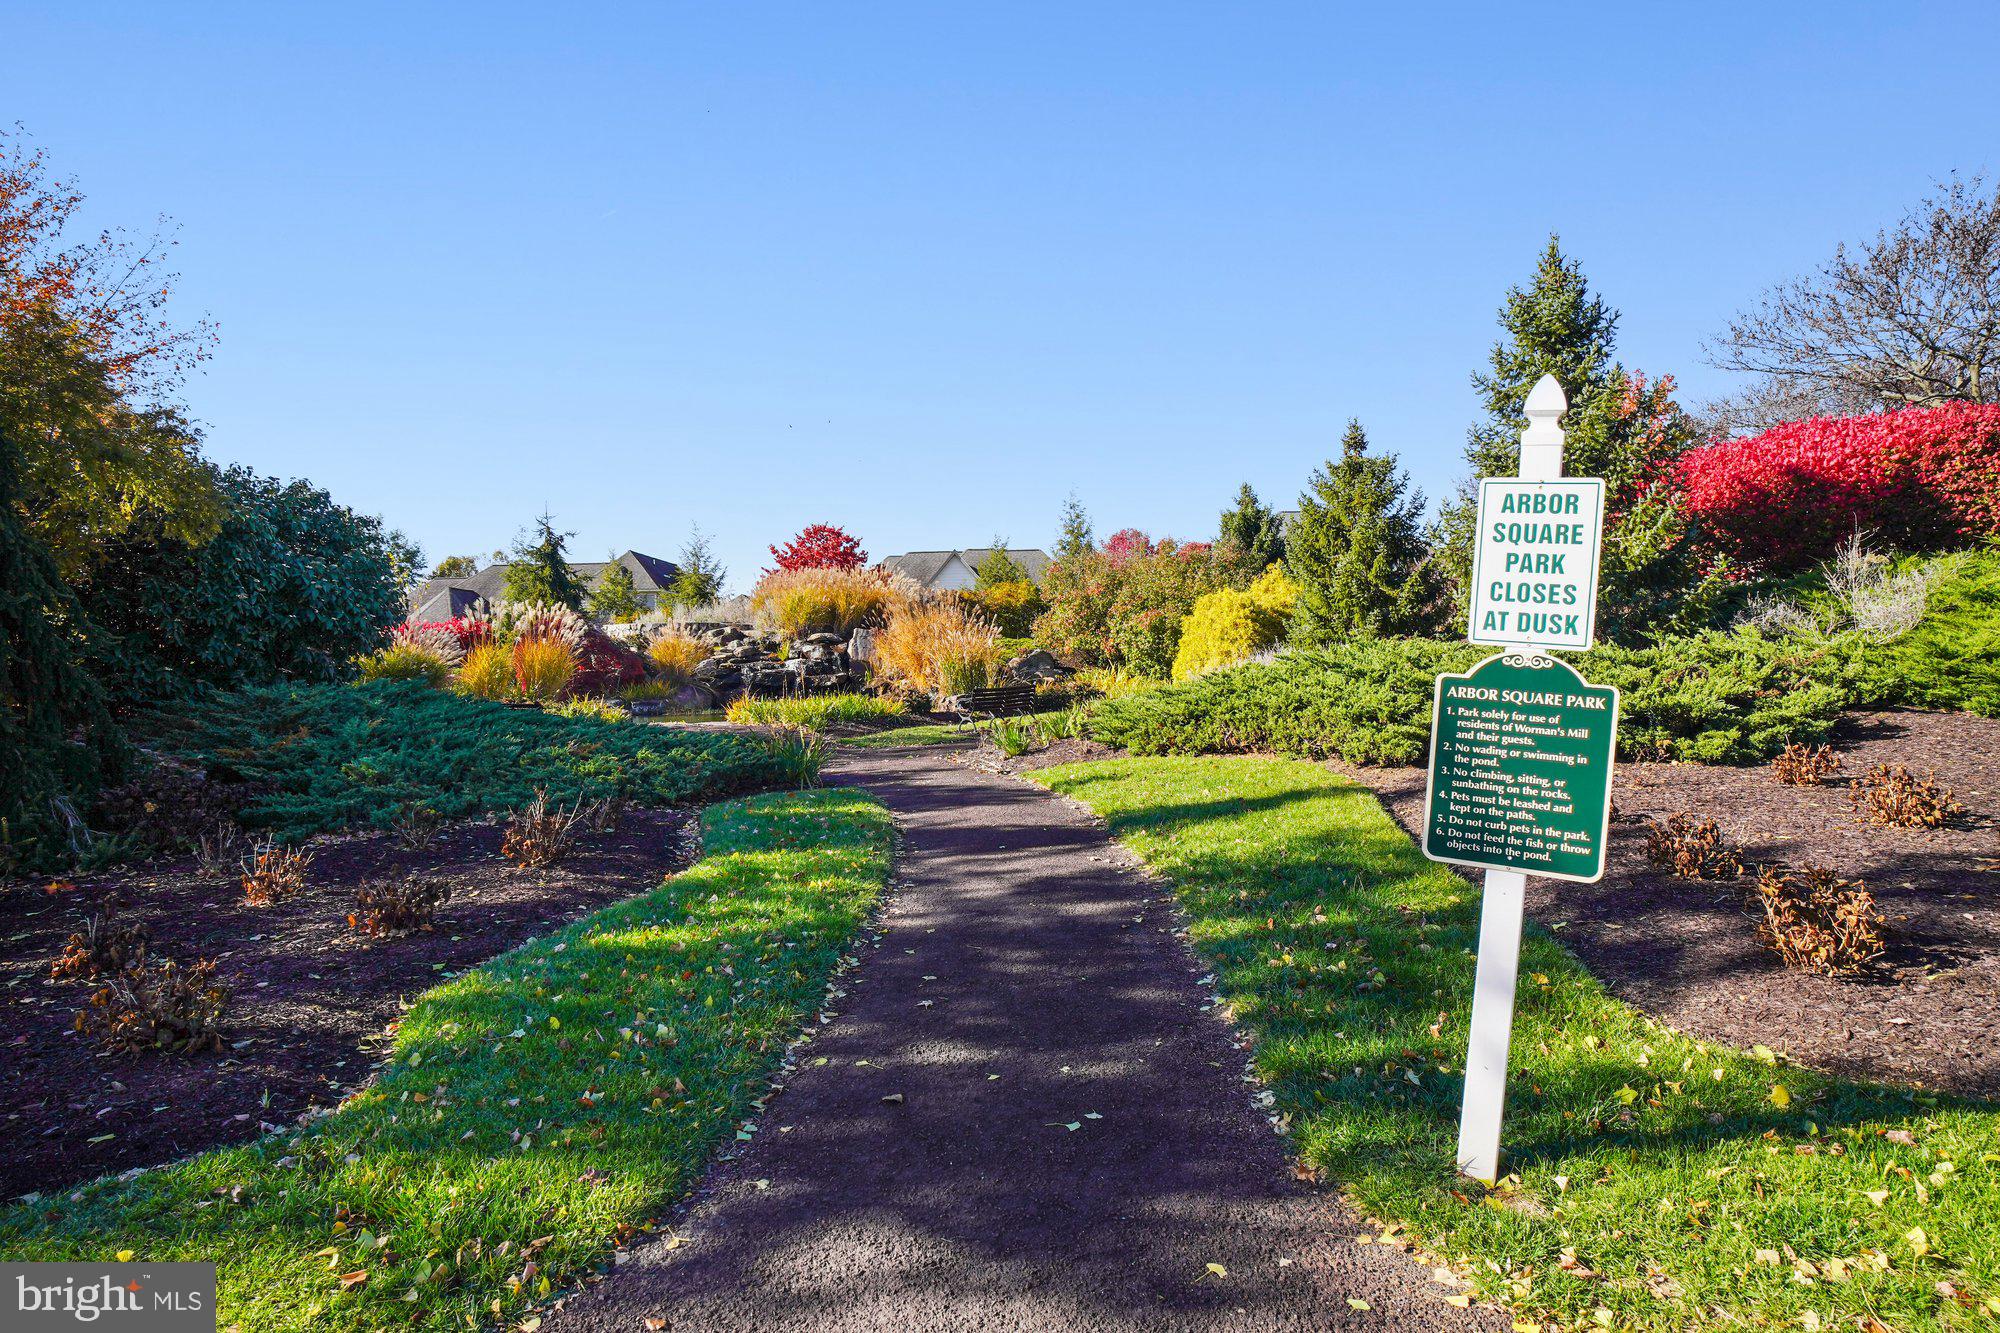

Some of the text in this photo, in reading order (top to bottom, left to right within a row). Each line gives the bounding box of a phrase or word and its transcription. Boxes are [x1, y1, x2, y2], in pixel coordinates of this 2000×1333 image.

[1501, 493, 1579, 514] ARBOR
[1492, 523, 1584, 545] SQUARE
[1505, 552, 1566, 574] PARK
[1490, 581, 1577, 605] CLOSES
[1483, 611, 1580, 635] AT DUSK
[1447, 686, 1606, 709] ARBOR SQUARE PARK
[1447, 706, 1560, 724] 1. Park solely for use of
[1456, 731, 1535, 745] and their guests.
[1457, 720, 1589, 738] residents of Worman's Mill
[1443, 742, 1587, 765] 2. No wading or swimming in
[1454, 754, 1500, 767] the pond.
[1441, 766, 1450, 774] 3.
[1453, 767, 1467, 776] No
[1470, 769, 1514, 783] climbing,
[1517, 774, 1551, 787] sitting,
[1452, 780, 1571, 800] sunbathing on the rocks.
[1439, 791, 1573, 813] 4. Pets must be leashed and
[1450, 802, 1471, 814] kept
[1488, 807, 1504, 816] the
[1506, 810, 1536, 820] paths.
[1437, 814, 1590, 841] 5. Do not curb pets in the park.
[1436, 827, 1445, 835] 6.
[1448, 828, 1462, 837] Do
[1465, 832, 1481, 840] not
[1484, 833, 1504, 843] feed
[1507, 836, 1522, 845] the
[1526, 838, 1544, 849] fish
[1560, 843, 1591, 855] throw
[1447, 840, 1552, 861] objects into the pond.
